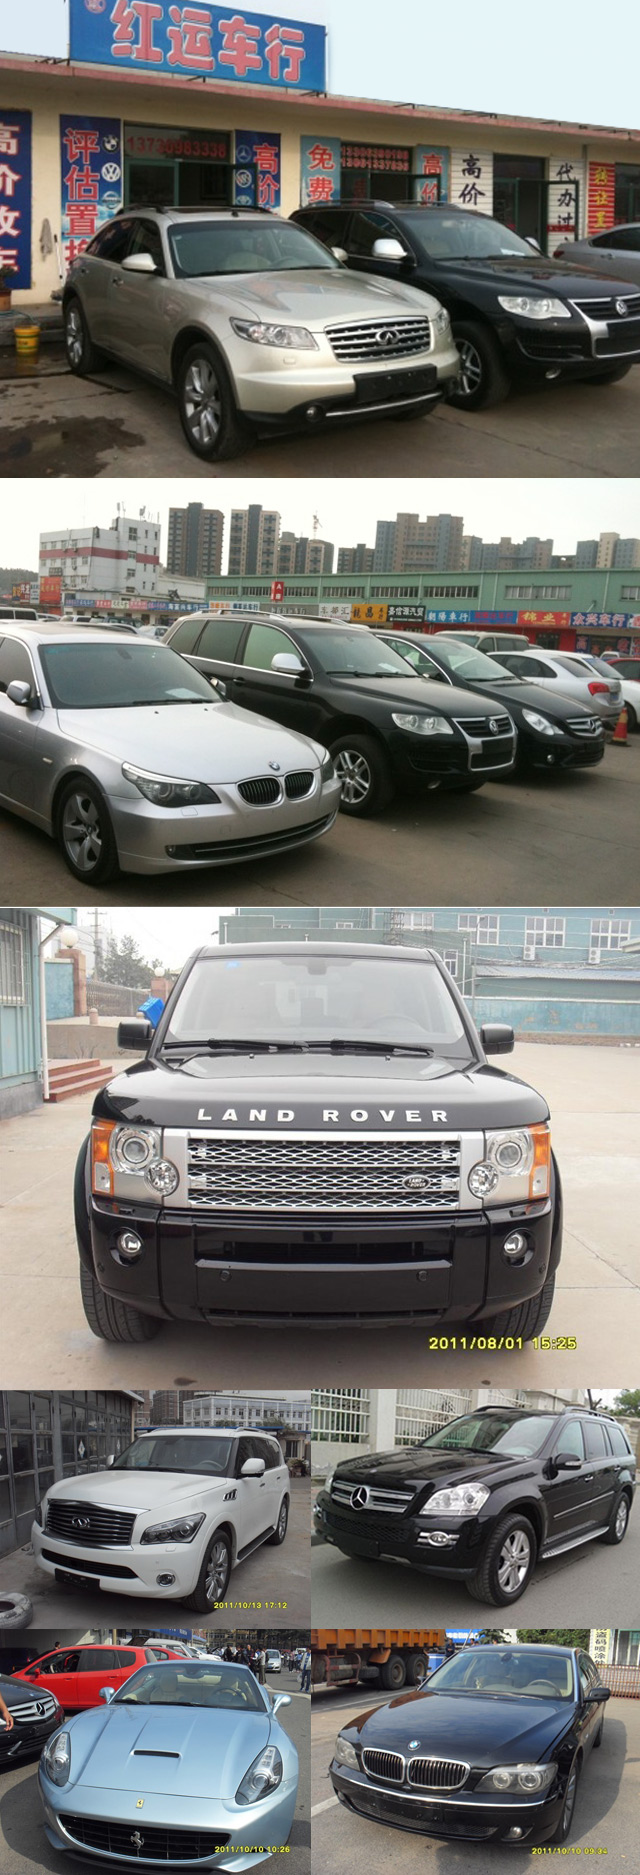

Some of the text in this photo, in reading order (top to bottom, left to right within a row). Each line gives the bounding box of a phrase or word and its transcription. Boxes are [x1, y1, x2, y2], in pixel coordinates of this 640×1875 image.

[110, 0, 305, 82] 红运车行
[254, 143, 280, 211] 高价
[307, 143, 336, 204] 免费
[458, 153, 486, 206] 高价
[556, 162, 576, 241] 代办过
[197, 1108, 449, 1122] LAND ROVER
